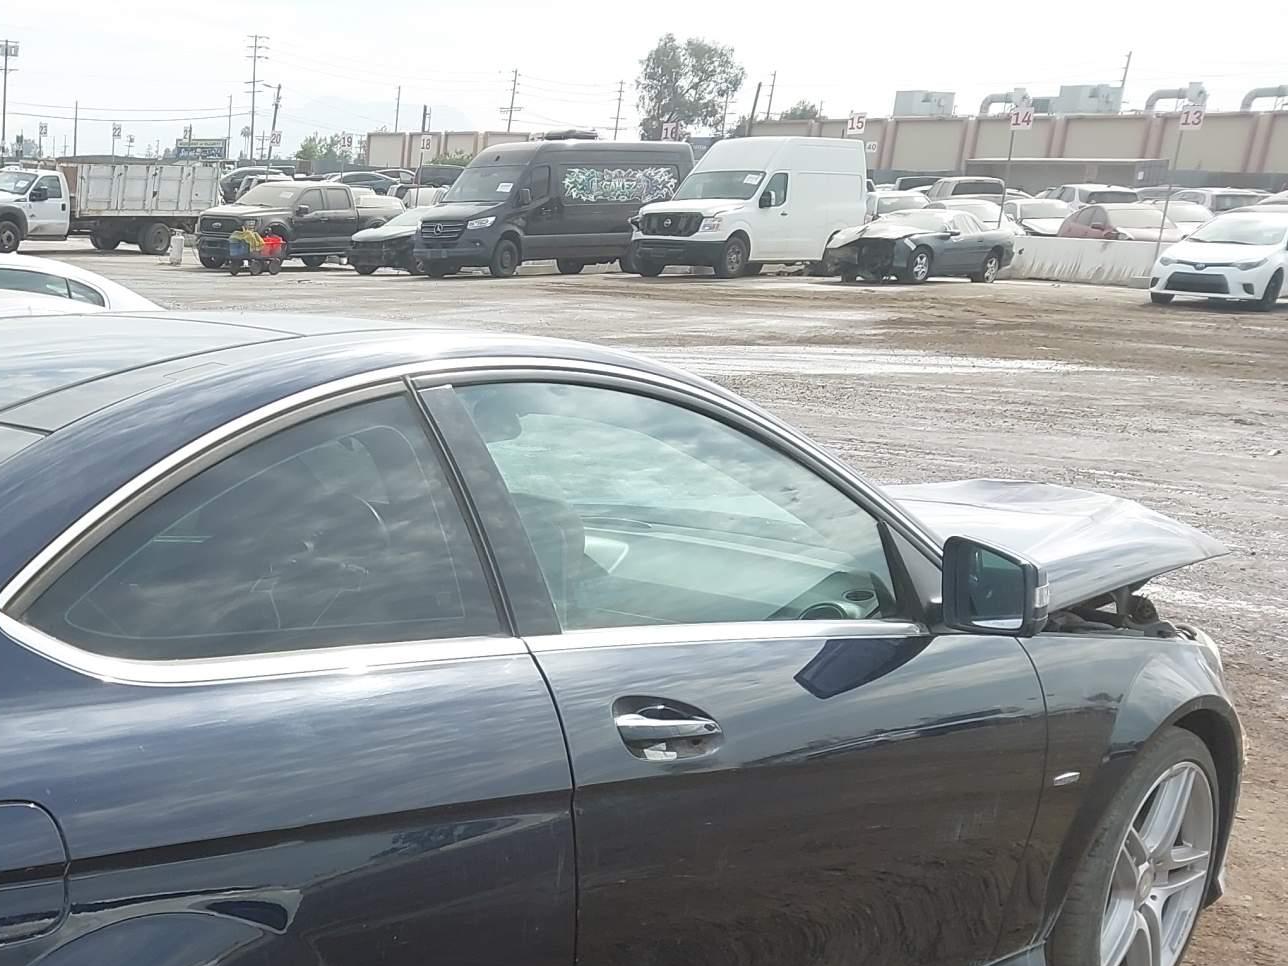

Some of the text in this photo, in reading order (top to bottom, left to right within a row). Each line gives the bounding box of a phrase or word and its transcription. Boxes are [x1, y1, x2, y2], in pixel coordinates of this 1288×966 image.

[848, 115, 865, 130] 15
[1011, 111, 1032, 126] 14
[1180, 110, 1203, 126] 13
[39, 125, 48, 135] 23
[112, 127, 122, 137] 22
[270, 133, 282, 145] 20
[341, 136, 353, 147] 19
[420, 138, 431, 150] 18
